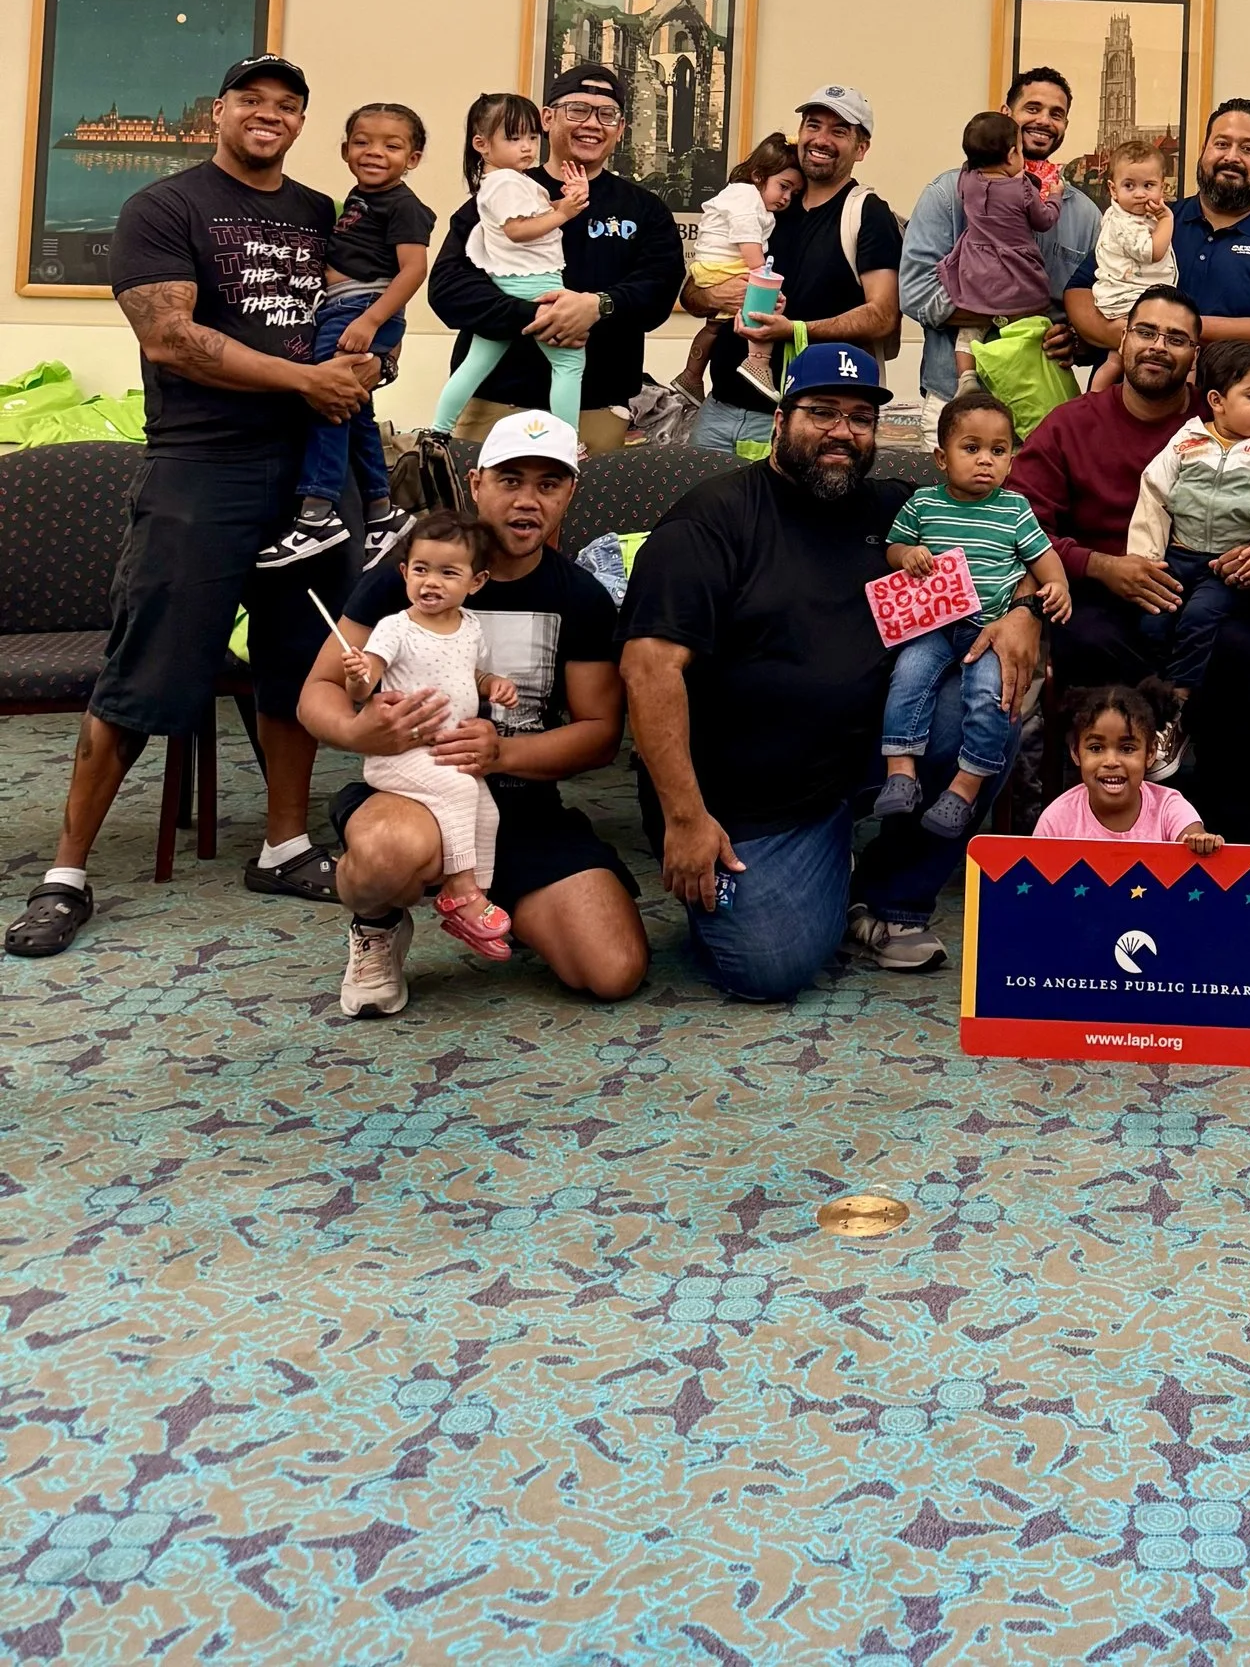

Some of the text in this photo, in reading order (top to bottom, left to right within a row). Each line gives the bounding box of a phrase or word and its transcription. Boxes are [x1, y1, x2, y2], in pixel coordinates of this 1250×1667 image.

[243, 241, 311, 262] THERE IS
[288, 275, 322, 291] WAS
[265, 309, 300, 329] WILL
[838, 351, 859, 379] LA
[884, 592, 971, 640] SUPER
[1006, 975, 1037, 988] LOS
[1042, 977, 1118, 991] ANGELES
[1124, 980, 1185, 994] PUBLIC
[1085, 1031, 1183, 1051] www.lapl.org
